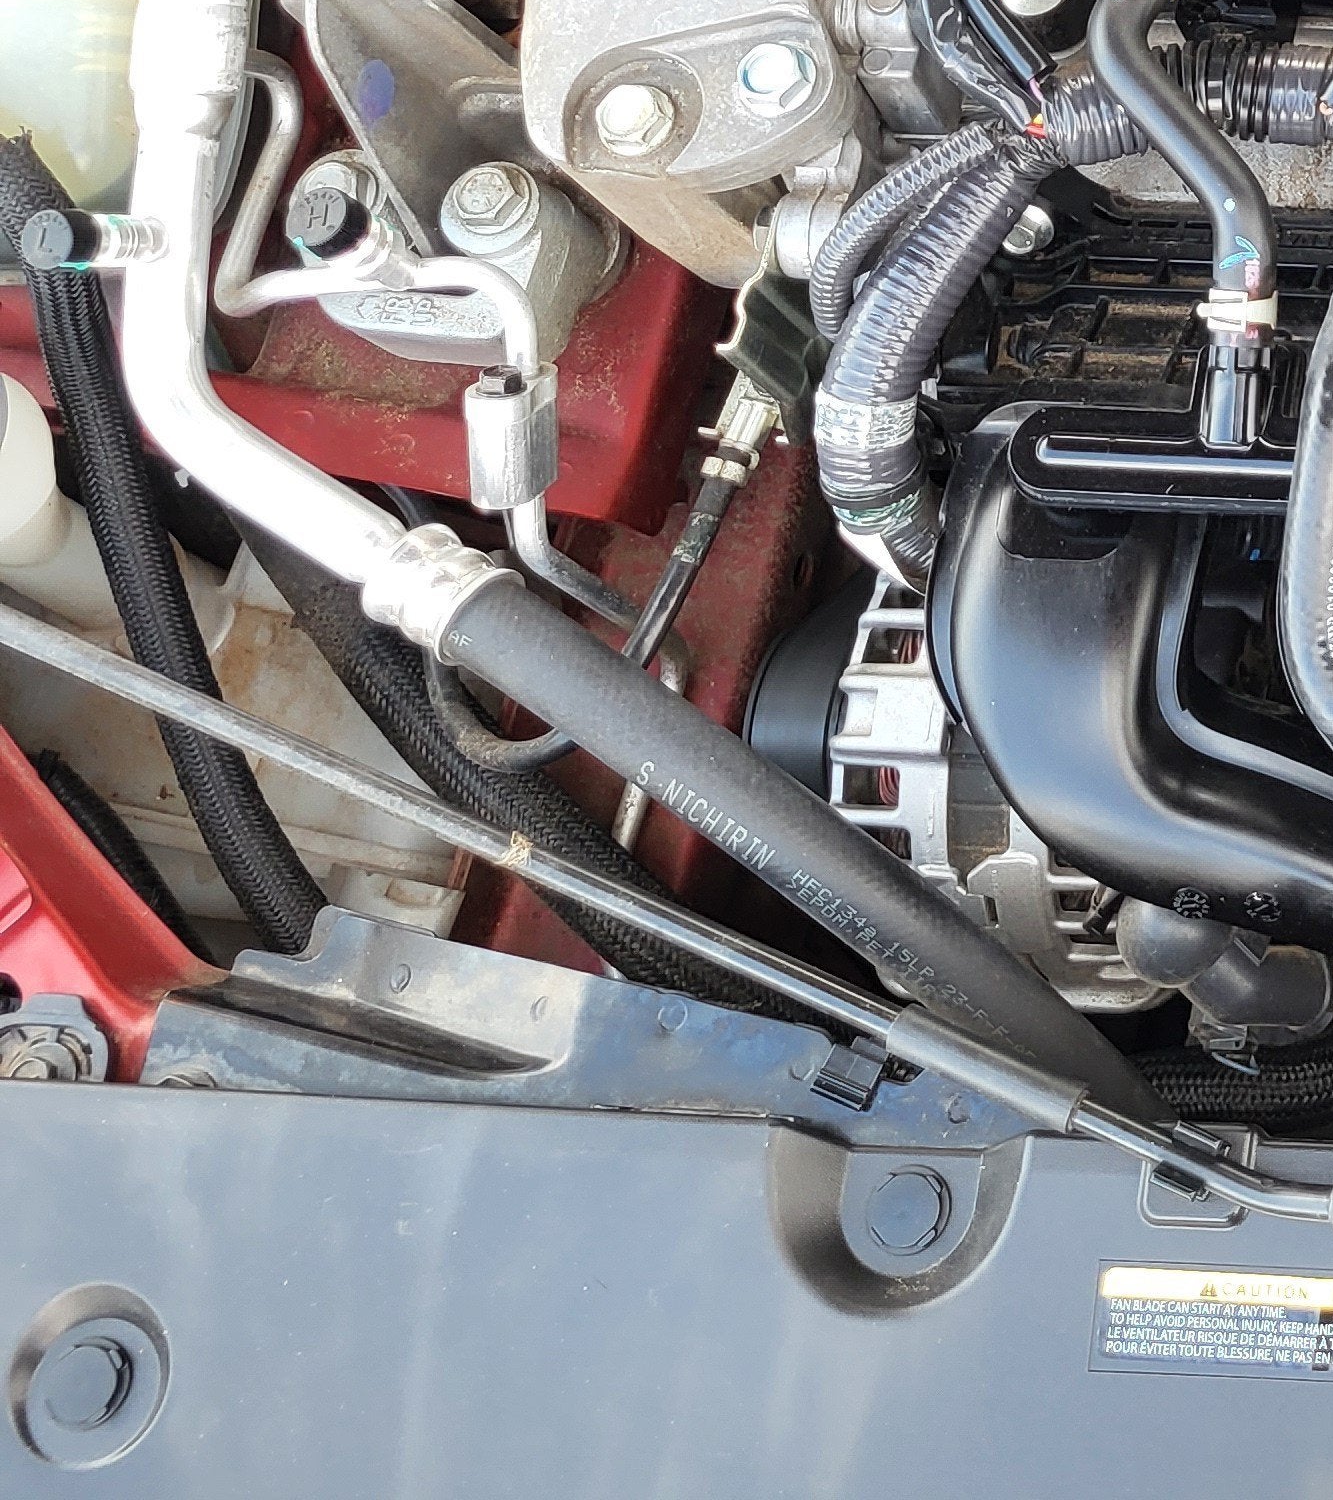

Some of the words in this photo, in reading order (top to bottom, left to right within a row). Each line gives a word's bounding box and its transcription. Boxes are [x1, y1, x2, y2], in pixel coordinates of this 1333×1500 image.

[1110, 1298, 1131, 1311] FAN
[1132, 1299, 1166, 1313] BLADE
[1167, 1301, 1189, 1314] CAN
[1191, 1302, 1223, 1315] START
[1222, 1303, 1238, 1316] AT
[1238, 1304, 1261, 1317] ANY
[1109, 1312, 1124, 1325] TO
[1125, 1313, 1153, 1326] HELP
[1153, 1314, 1185, 1327] AVOID
[1186, 1316, 1239, 1330] PERSONAL
[1279, 1321, 1303, 1333] KEEP
[1107, 1326, 1122, 1339] LE
[1122, 1327, 1195, 1342] VENTILATEUR
[1196, 1331, 1238, 1346] RISQUE
[1239, 1333, 1255, 1345] DE
[1105, 1341, 1139, 1353] POUR
[1177, 1344, 1214, 1357] TOUTE
[1275, 1349, 1292, 1361] NE
[1292, 1350, 1312, 1363] PAS
[1314, 1352, 1331, 1364] EN
